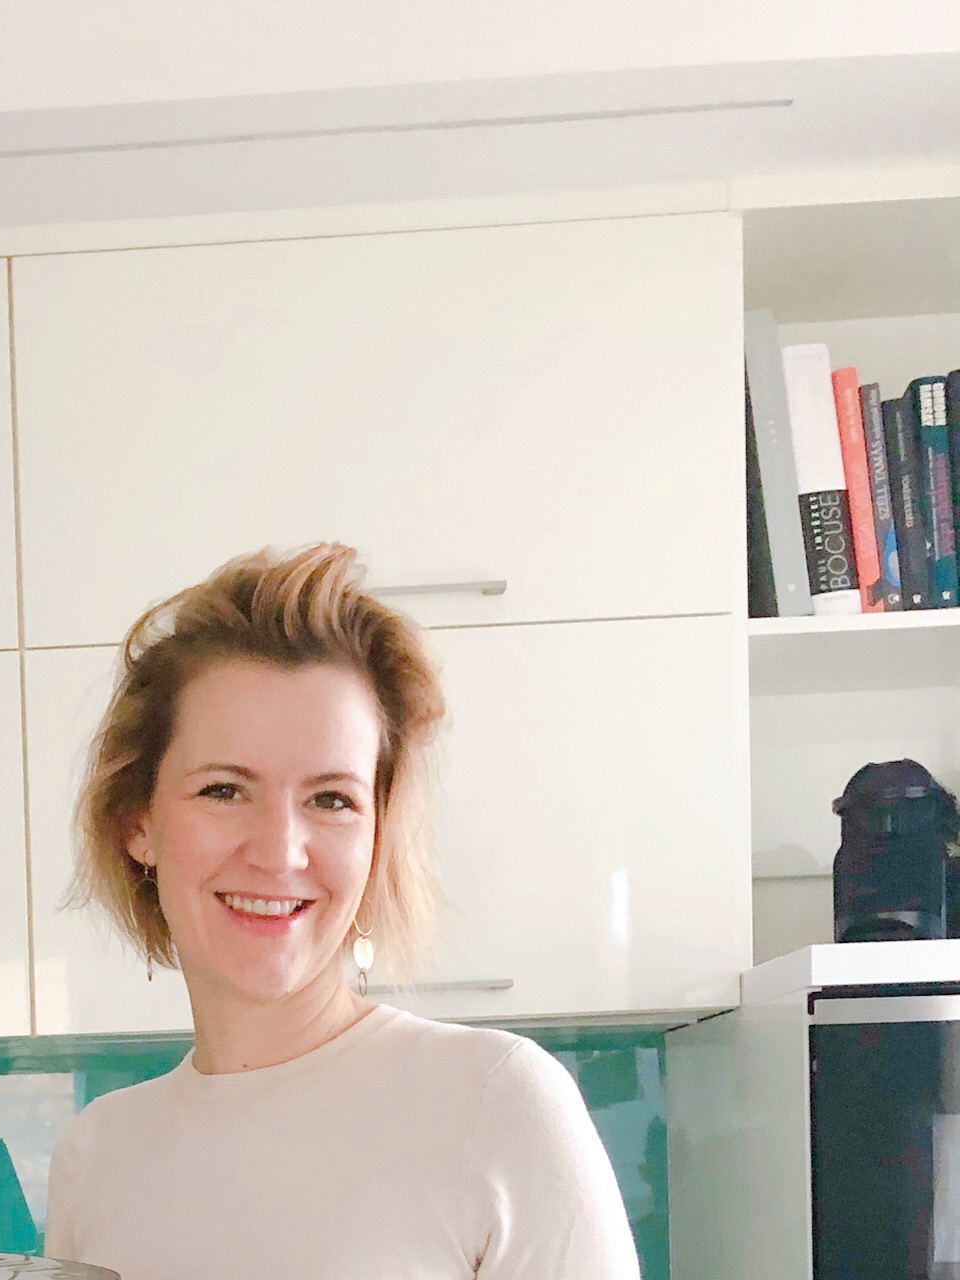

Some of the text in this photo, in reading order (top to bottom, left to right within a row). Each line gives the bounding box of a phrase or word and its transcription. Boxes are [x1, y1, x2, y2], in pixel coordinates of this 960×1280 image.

[870, 439, 886, 484] TAMÁS
[819, 492, 851, 590] BOCUSE
[818, 559, 829, 591] PAUL
